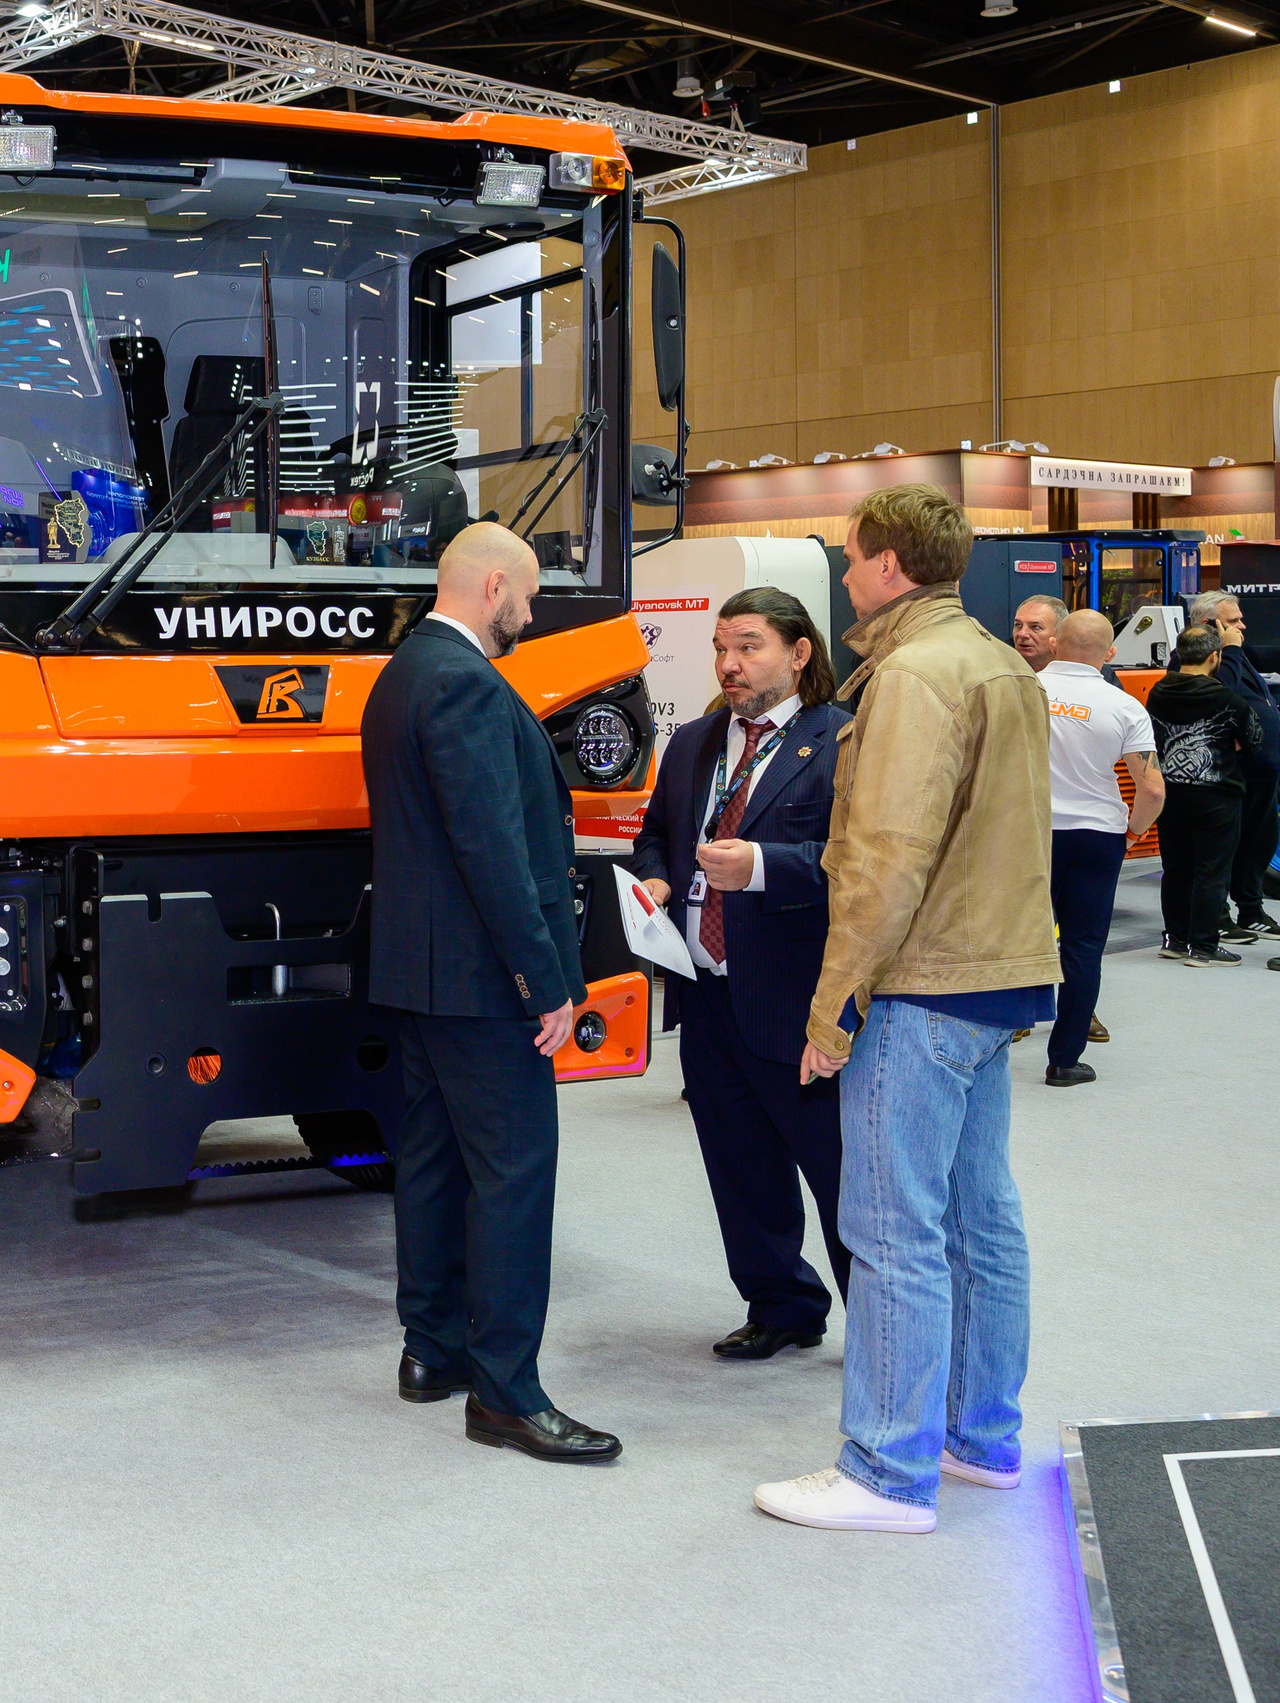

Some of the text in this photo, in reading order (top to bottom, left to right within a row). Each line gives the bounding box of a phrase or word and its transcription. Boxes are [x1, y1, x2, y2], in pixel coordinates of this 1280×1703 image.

[1039, 466, 1185, 487] САРДЭЧНА ЗАПРАШАЕМ!
[1200, 533, 1225, 545] AN
[685, 600, 704, 609] MT
[153, 606, 376, 640] УНИРОСС
